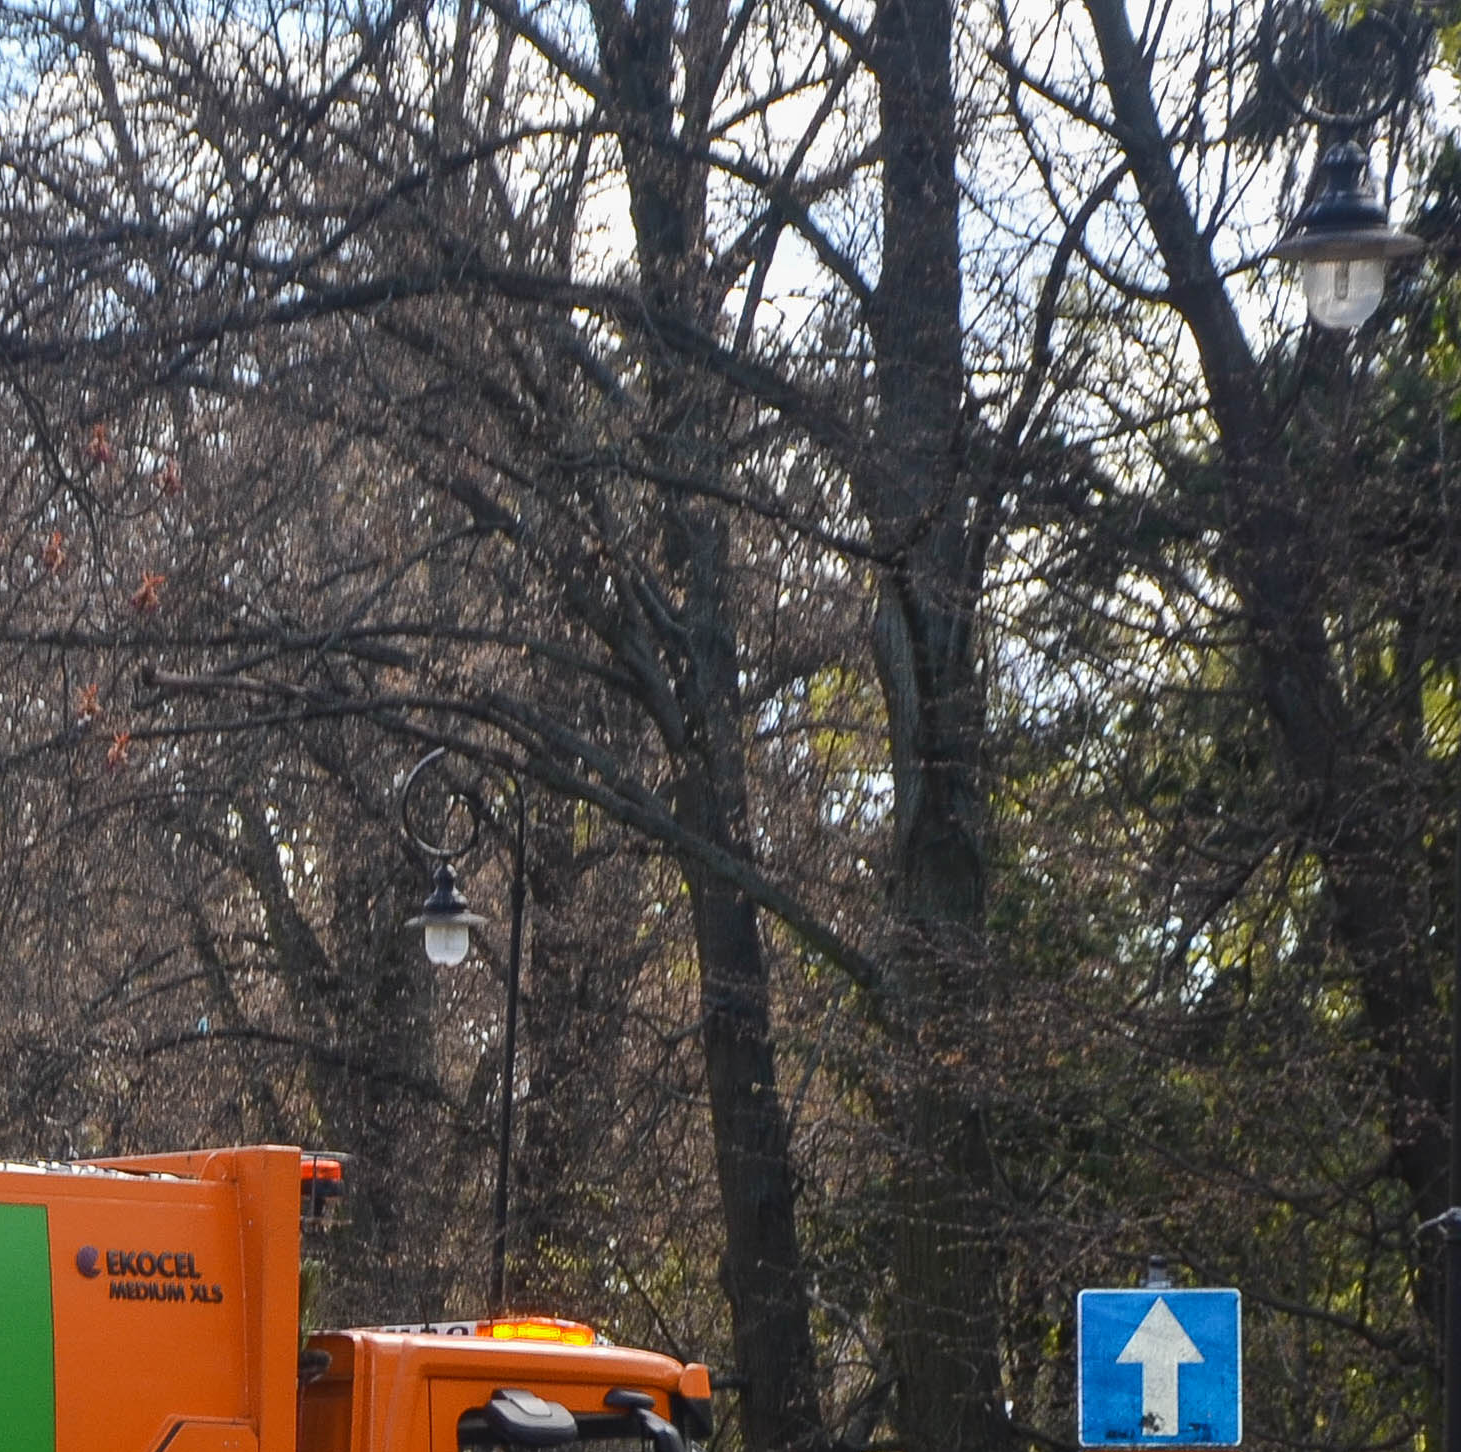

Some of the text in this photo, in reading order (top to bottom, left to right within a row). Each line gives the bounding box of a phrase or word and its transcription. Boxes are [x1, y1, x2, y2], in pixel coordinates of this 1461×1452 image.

[107, 1250, 202, 1279] EKOCEL
[110, 1281, 224, 1303] MEDIUM XLS
